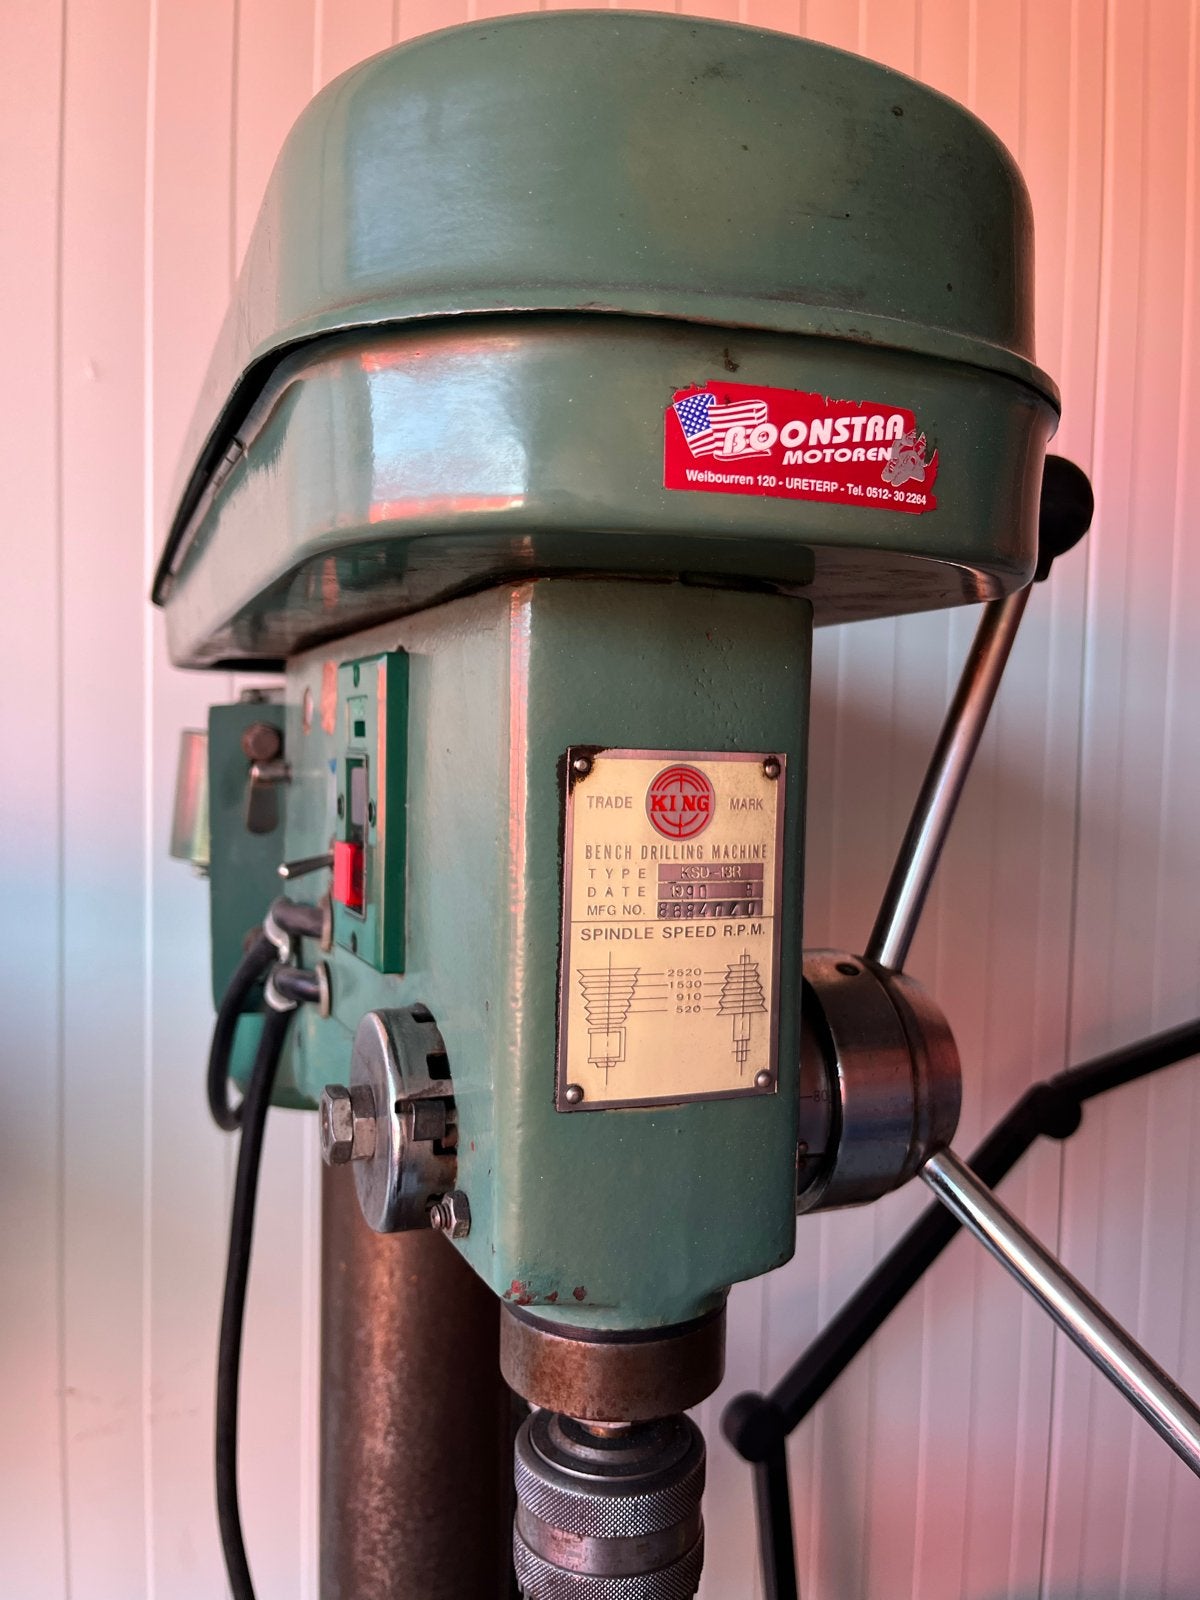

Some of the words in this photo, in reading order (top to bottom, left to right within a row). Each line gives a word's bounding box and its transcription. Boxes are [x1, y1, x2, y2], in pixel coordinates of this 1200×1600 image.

[722, 415, 904, 454] BOONSTRA
[782, 447, 893, 465] MOTOREN
[686, 469, 753, 486] Weibourren
[757, 475, 776, 487] 120
[785, 478, 838, 493] URETERP
[847, 483, 864, 496] Tel.
[587, 796, 632, 809] TRADE
[650, 795, 710, 812] KING
[729, 798, 763, 811] MARK
[585, 845, 632, 860] BENCH
[641, 844, 703, 860] DRILLING
[712, 844, 767, 859] MACHINE
[588, 868, 646, 879] TYPE
[587, 886, 646, 898] DATE
[587, 905, 616, 916] MFG
[622, 904, 646, 915] NO.
[580, 927, 654, 941] SPINDLE
[662, 926, 716, 939] SPEED
[723, 924, 765, 937] R.P.M.
[676, 992, 702, 1001] 910
[676, 1005, 701, 1013] 520
